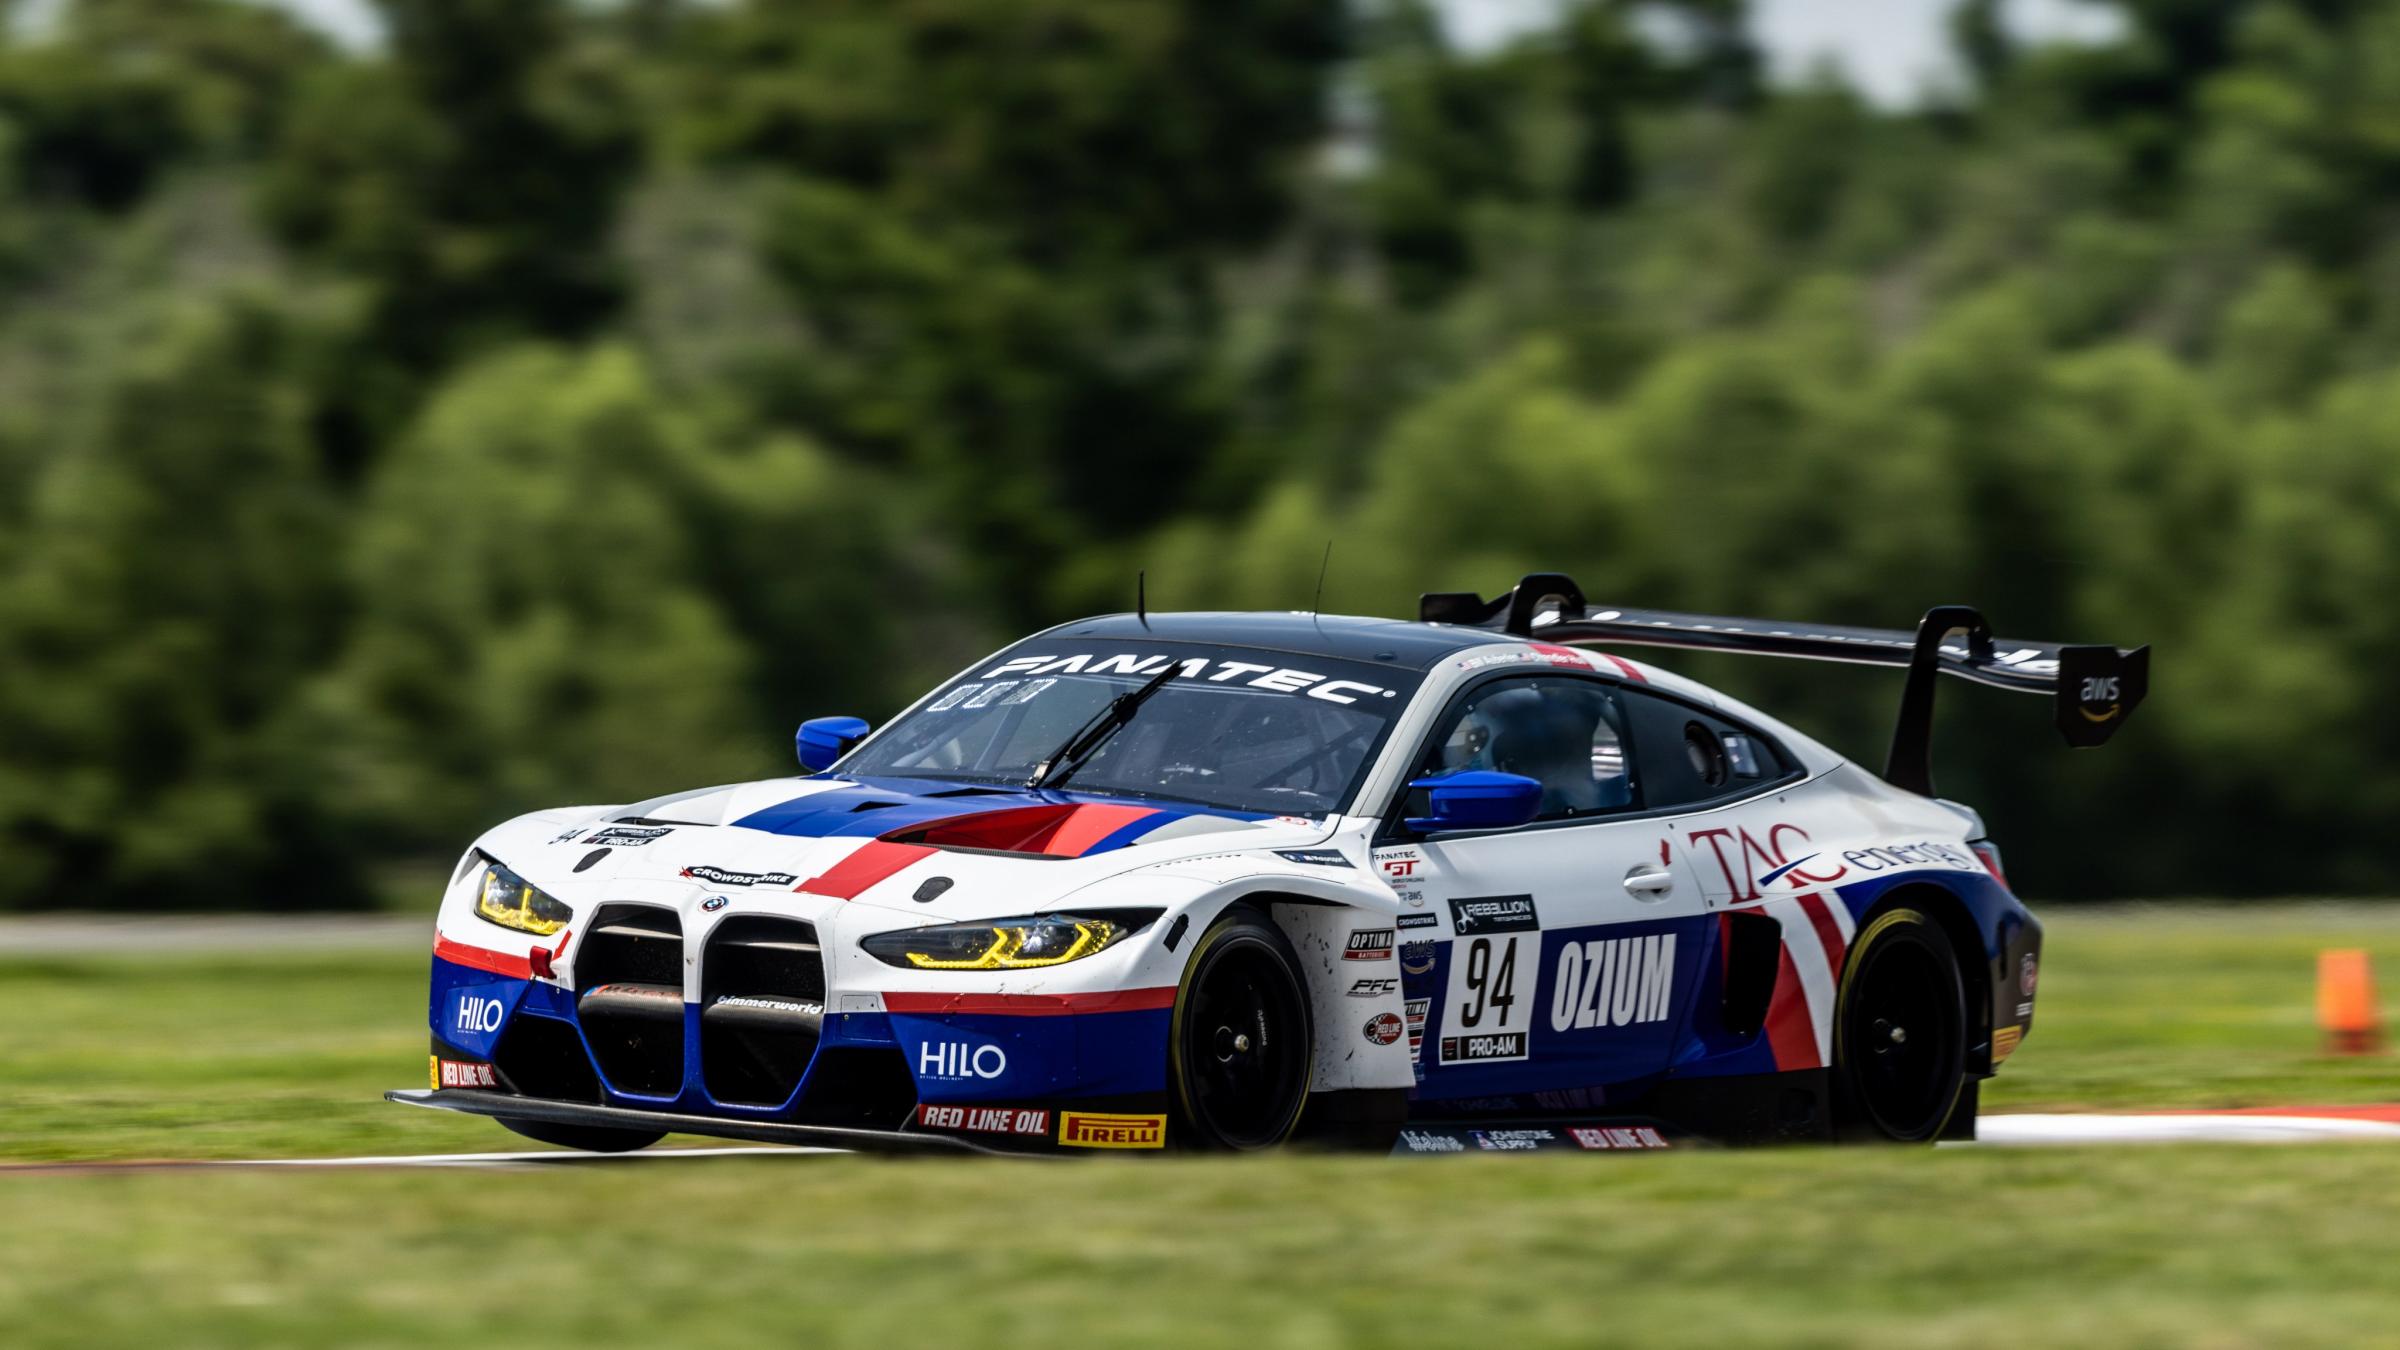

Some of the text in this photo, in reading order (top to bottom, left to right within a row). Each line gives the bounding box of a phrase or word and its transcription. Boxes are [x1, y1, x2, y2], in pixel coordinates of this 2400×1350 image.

[981, 654, 1386, 705] FANATEC
[2080, 677, 2120, 701] aws
[1373, 850, 1416, 860] FANATEC
[1688, 823, 1973, 904] TAC energy
[691, 867, 791, 884] CROWDSTRIKE
[1384, 860, 1420, 876] GT
[1466, 900, 1531, 916] REBELLION
[1350, 932, 1393, 949] OPTIMA
[1404, 939, 1435, 960] aws
[1350, 979, 1399, 991] PFC
[1461, 937, 1517, 1028] 94
[1551, 933, 1678, 1033] OZIUM
[457, 996, 503, 1032] HILO
[716, 995, 824, 1015] bimmerworld
[1469, 1035, 1516, 1057] PRO-AM
[919, 1041, 1006, 1079] HILO
[443, 1062, 458, 1085] RED
[458, 1063, 479, 1086] LINE
[477, 1065, 496, 1086] OIL
[924, 1106, 1045, 1134] RED LINE OIL
[1066, 1115, 1161, 1143] PIRELLI
[1572, 1128, 1669, 1148] RED LINE OIL
